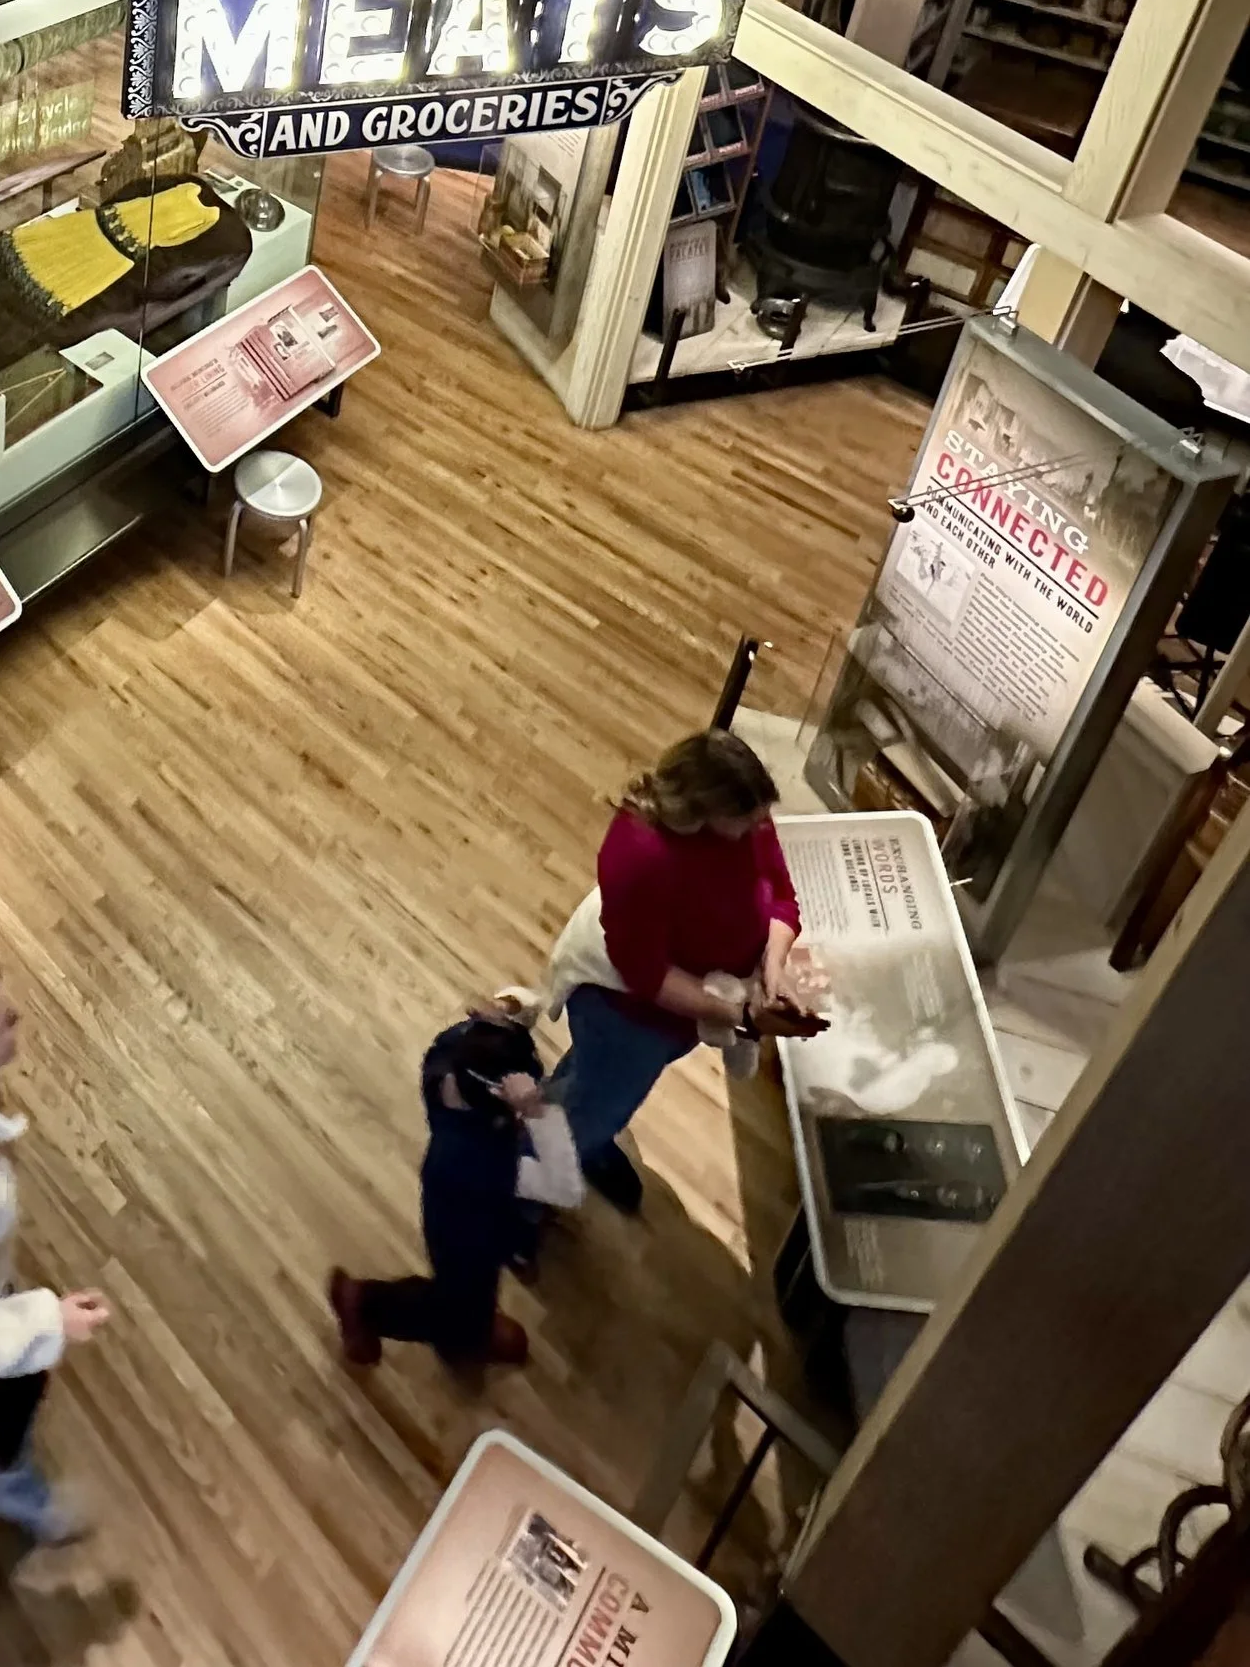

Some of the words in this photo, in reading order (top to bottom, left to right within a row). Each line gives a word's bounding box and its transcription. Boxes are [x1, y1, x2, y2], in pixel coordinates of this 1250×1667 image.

[268, 105, 351, 153] AND
[362, 85, 600, 142] GROCERIES
[944, 429, 1090, 555] STAYING
[920, 499, 939, 521] AND
[940, 514, 964, 541] EACH
[965, 537, 996, 570] OTHER
[925, 485, 1003, 556] COMMUNICATING
[1004, 551, 1033, 582] WITH
[1033, 575, 1055, 601] THE
[1056, 595, 1094, 635] WORLD
[936, 452, 1109, 608] CONNECTED
[871, 837, 899, 900] WORDS
[889, 836, 923, 931] EXCHANGING
[630, 1590, 652, 1614] A
[606, 1624, 639, 1667] MI
